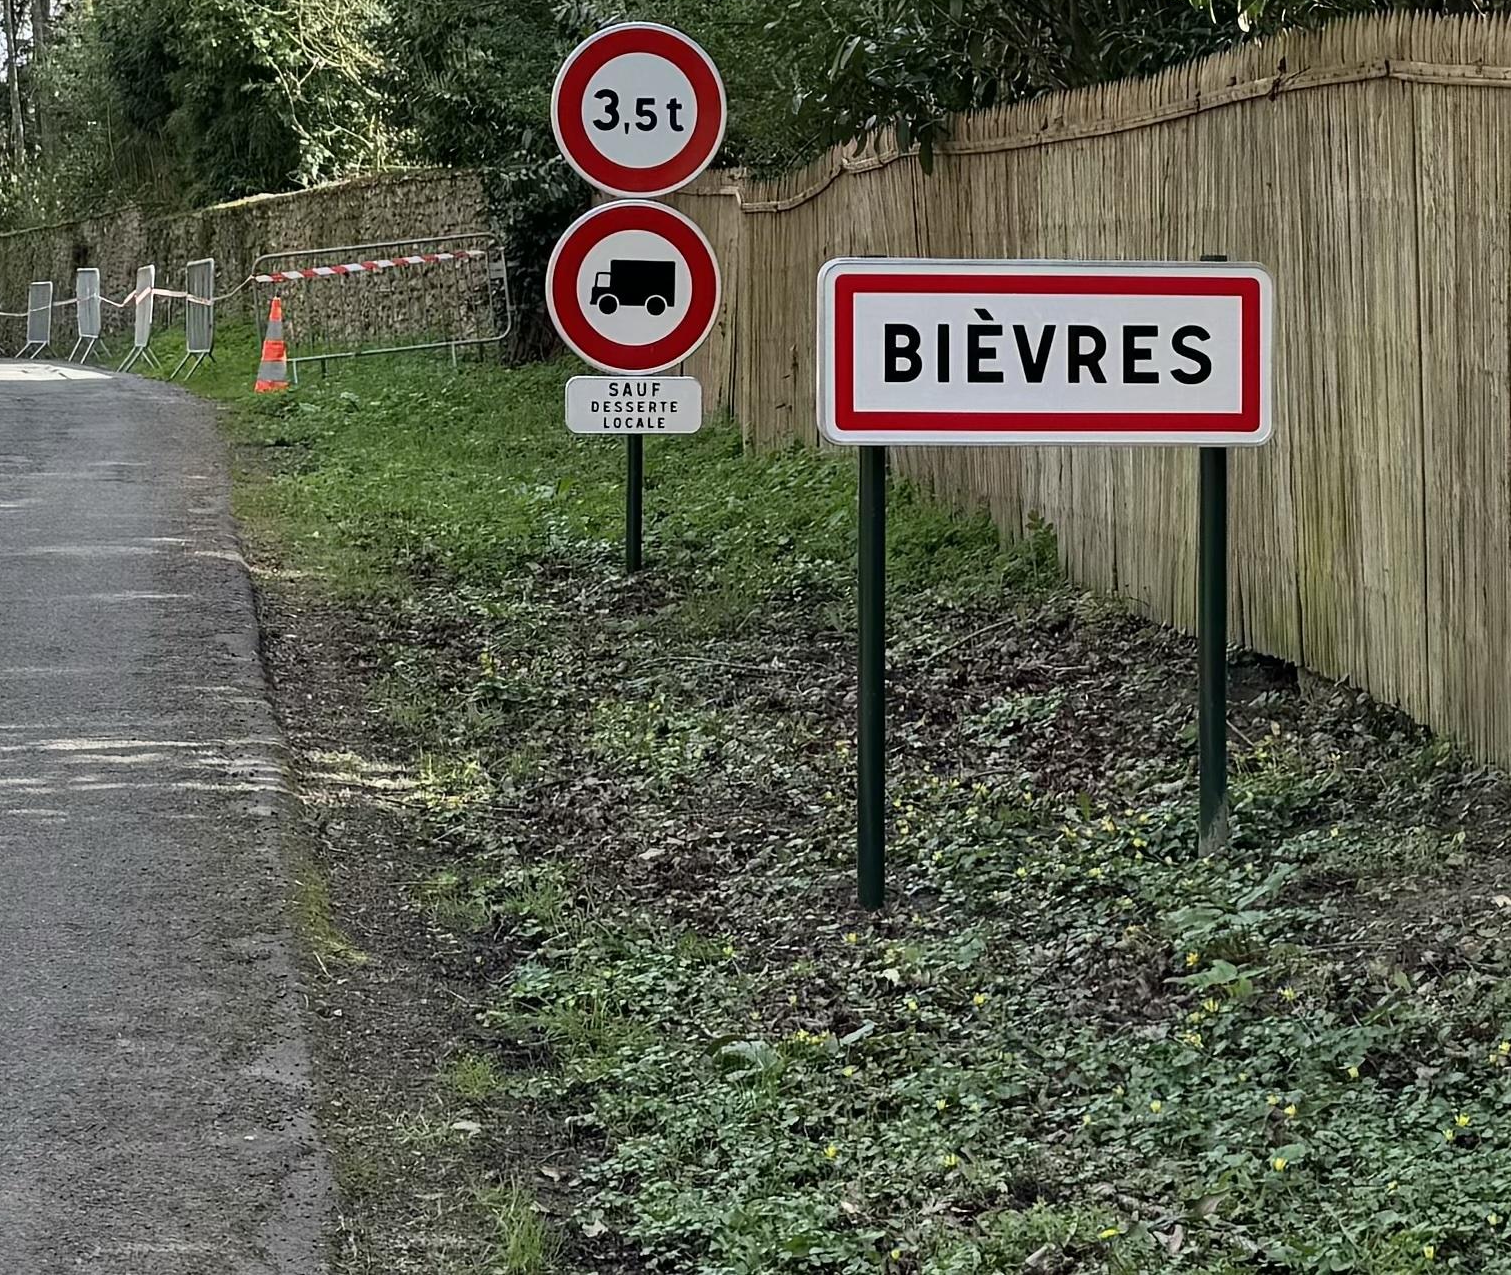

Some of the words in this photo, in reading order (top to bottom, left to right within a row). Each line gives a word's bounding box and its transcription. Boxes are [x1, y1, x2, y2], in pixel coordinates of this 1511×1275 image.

[883, 307, 1213, 385] BIÈVRES
[608, 382, 661, 397] SAUF
[591, 400, 678, 413] DESSERTE
[603, 416, 665, 429] LOCALE
